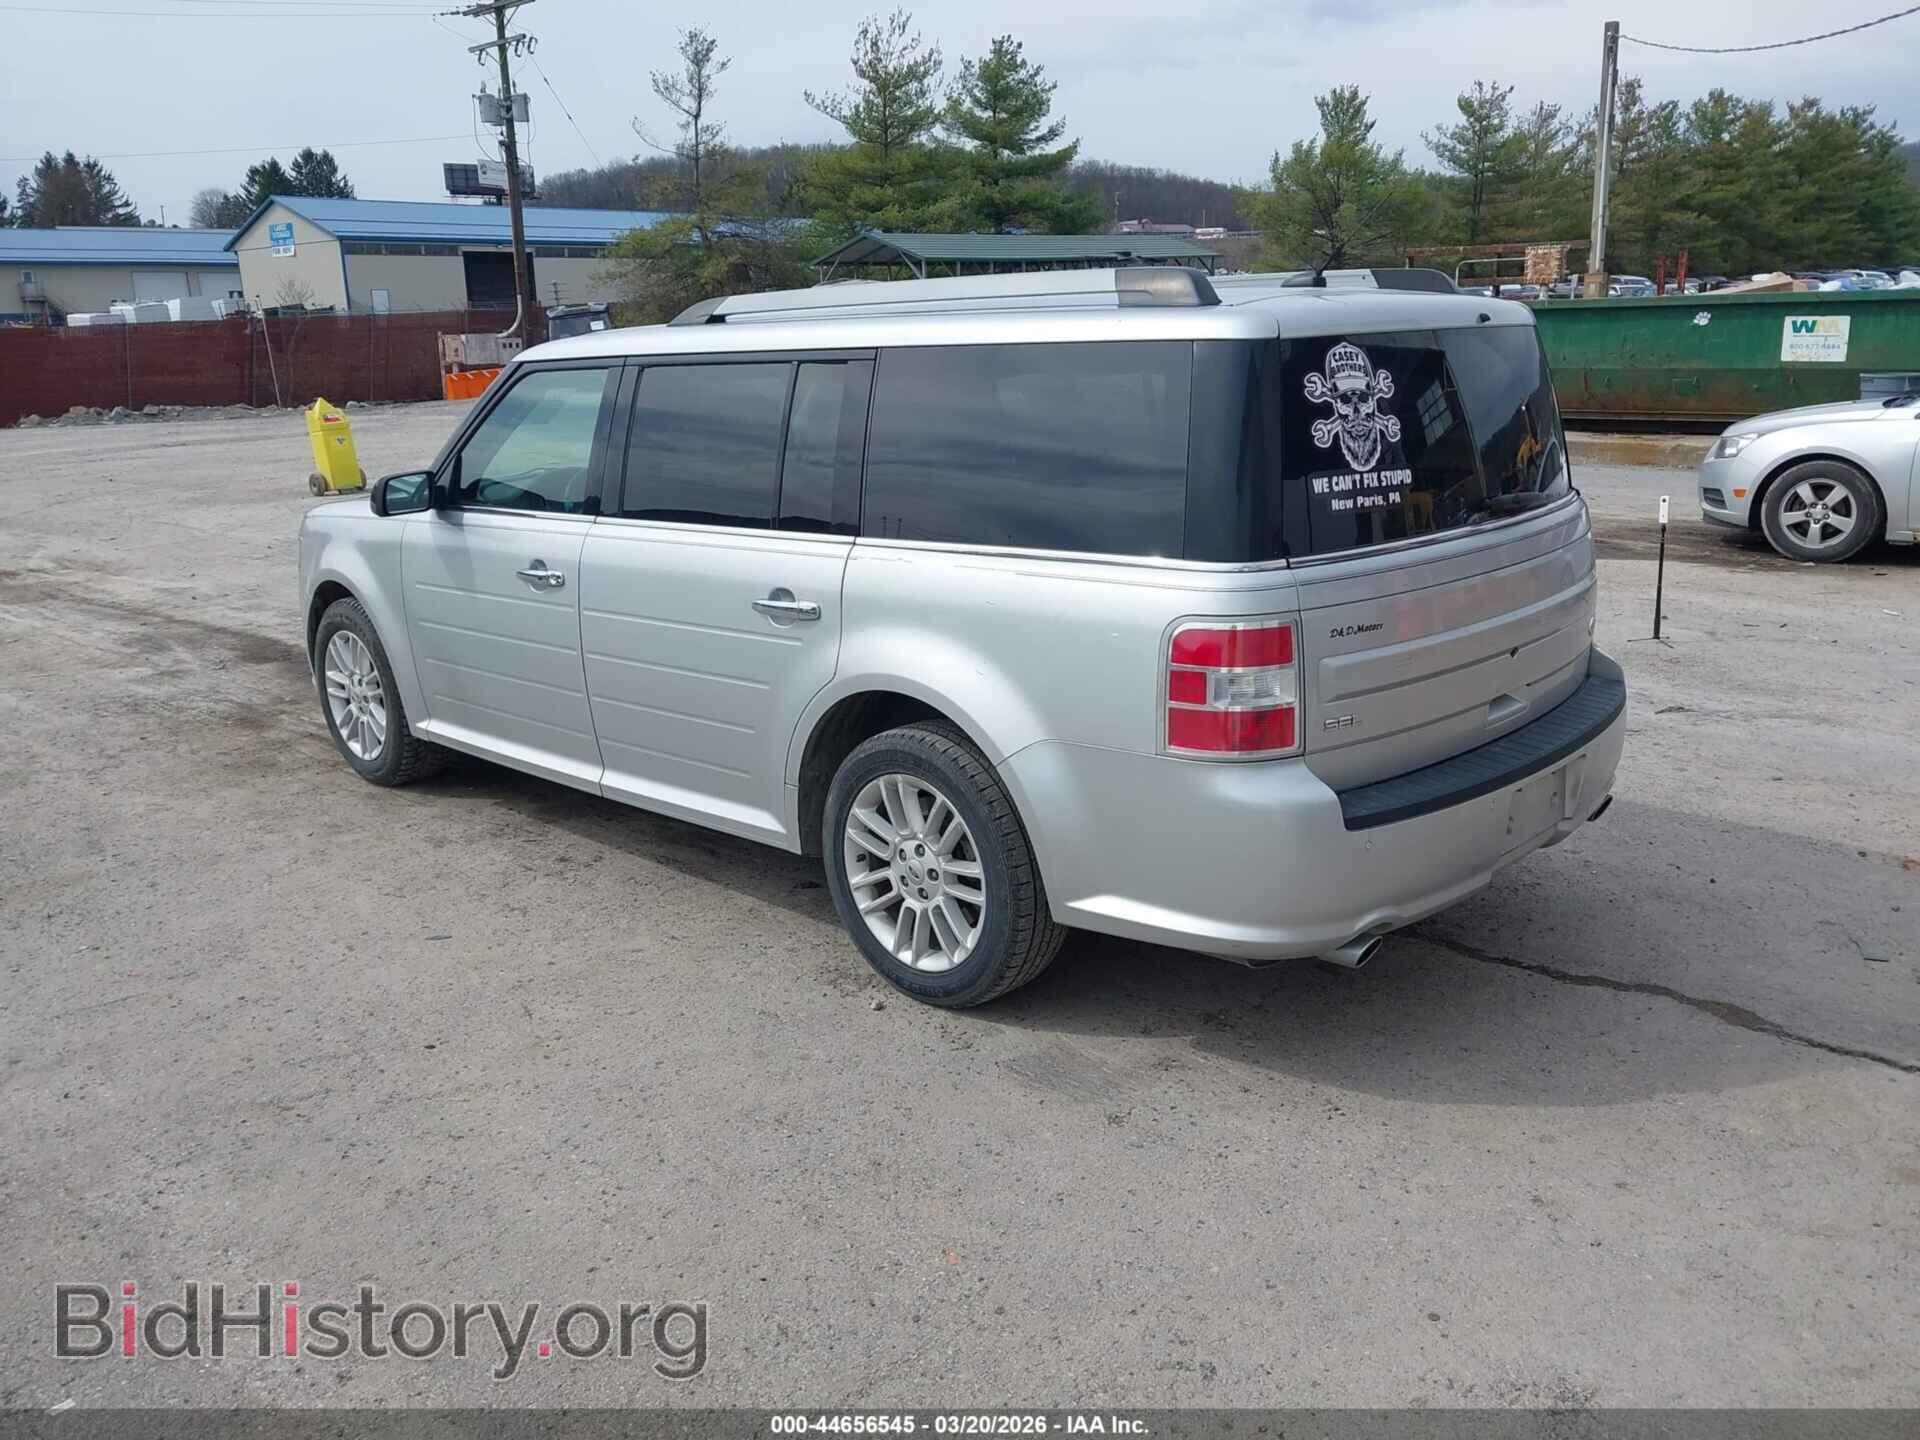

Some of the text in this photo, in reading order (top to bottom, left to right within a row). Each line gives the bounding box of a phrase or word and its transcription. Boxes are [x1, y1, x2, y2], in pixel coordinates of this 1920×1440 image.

[1332, 351, 1360, 363] CASEY
[1312, 469, 1412, 494] WE CAN'T FIX STUPID
[1331, 491, 1401, 511] New Paris, PA
